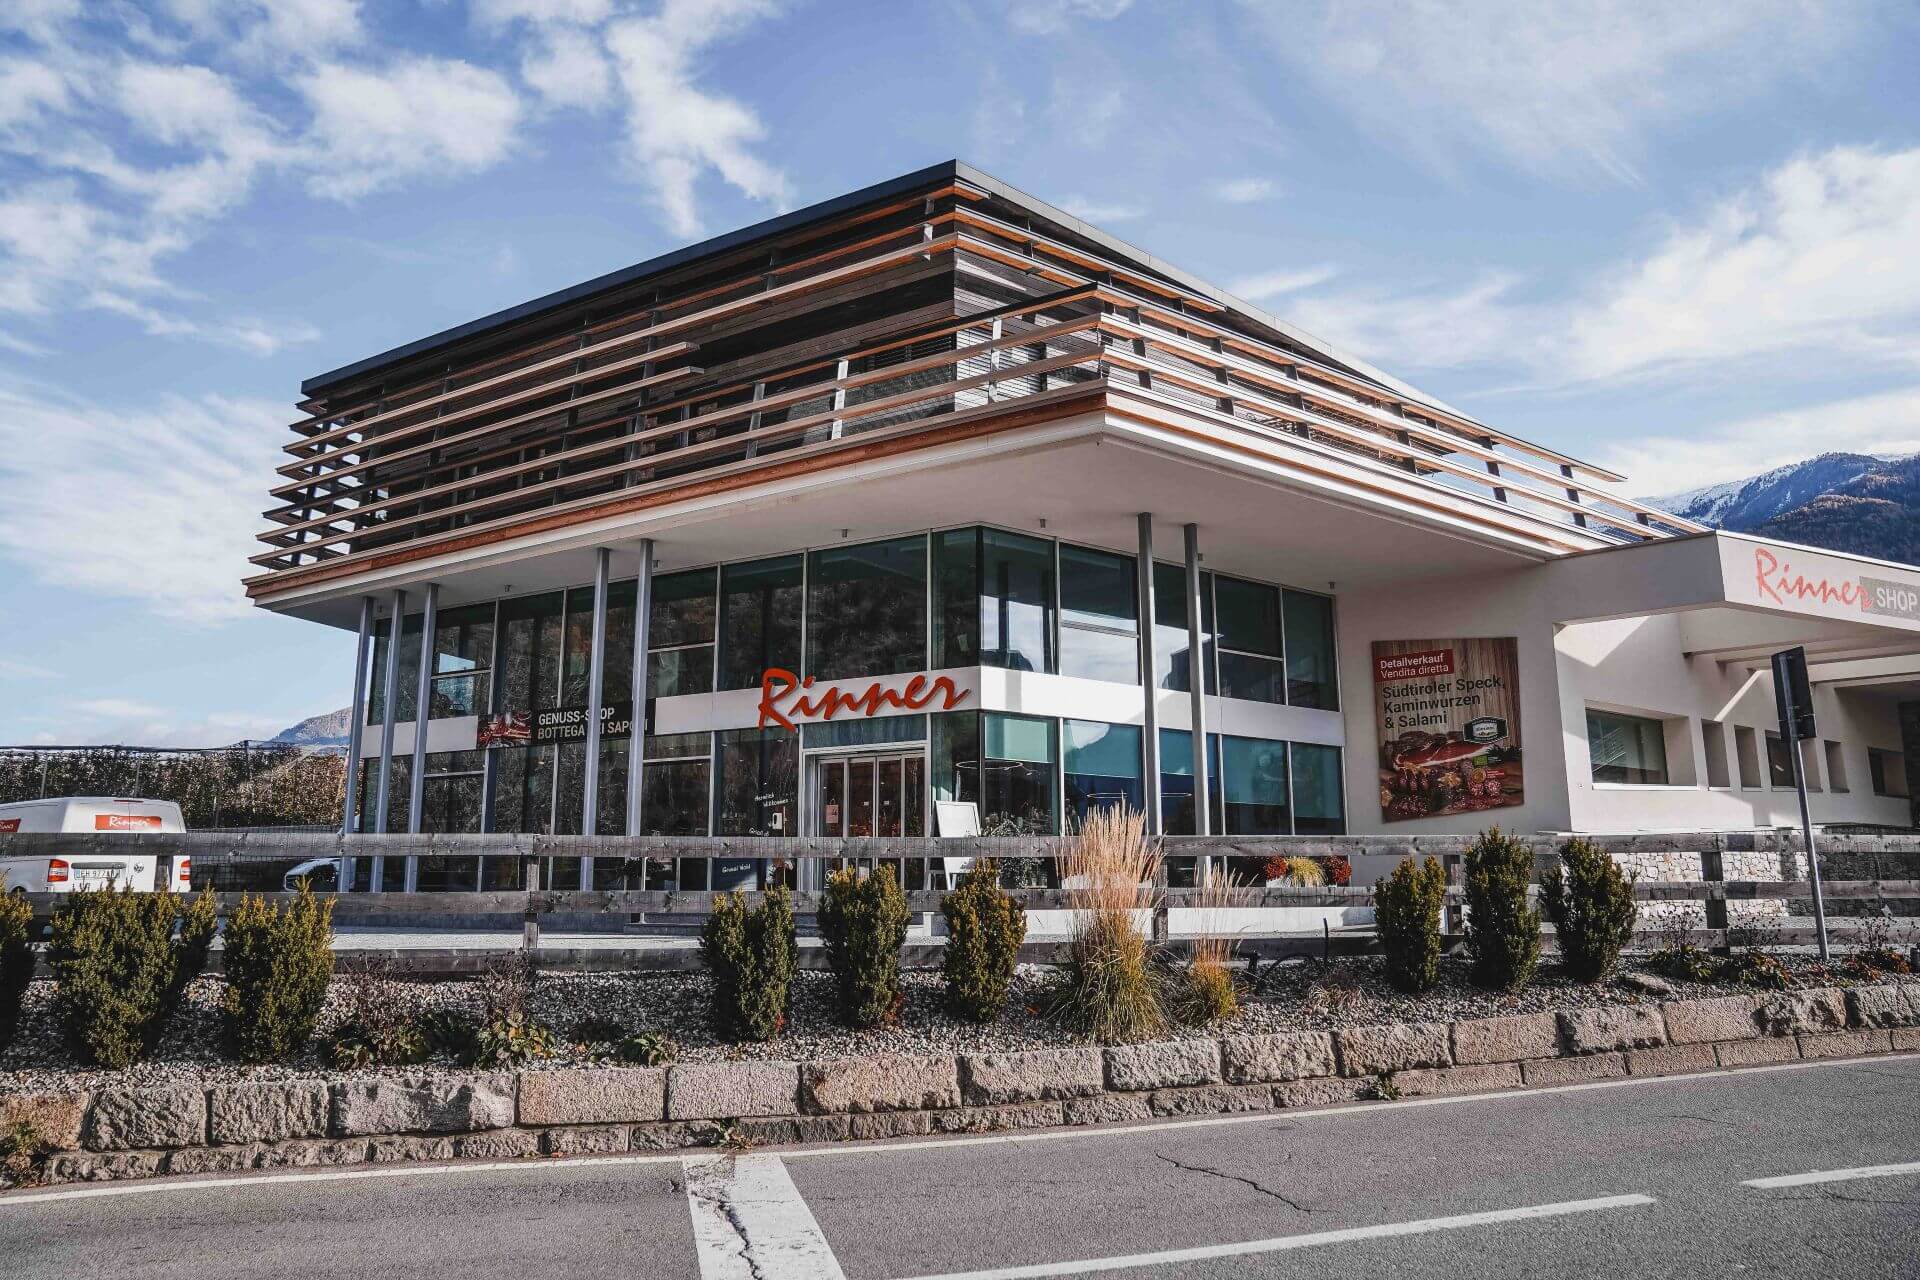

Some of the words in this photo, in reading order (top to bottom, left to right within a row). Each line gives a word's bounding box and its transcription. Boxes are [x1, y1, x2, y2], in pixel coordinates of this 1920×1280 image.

[1755, 548, 1873, 612] Rinner
[1876, 587, 1918, 612] SHOP
[1380, 652, 1445, 669] Detailverkauf
[1380, 666, 1416, 679] Vendita
[1418, 663, 1449, 675] diretta
[1383, 681, 1452, 699] Südtiroler
[758, 667, 972, 733] Rinner
[1383, 694, 1481, 714] Kaminwurzen
[538, 707, 616, 726] GENUSS-SOP
[1385, 716, 1395, 729] &
[1398, 710, 1448, 728] Salami
[537, 723, 585, 740] BOTTEGA
[607, 718, 648, 734] SAPI
